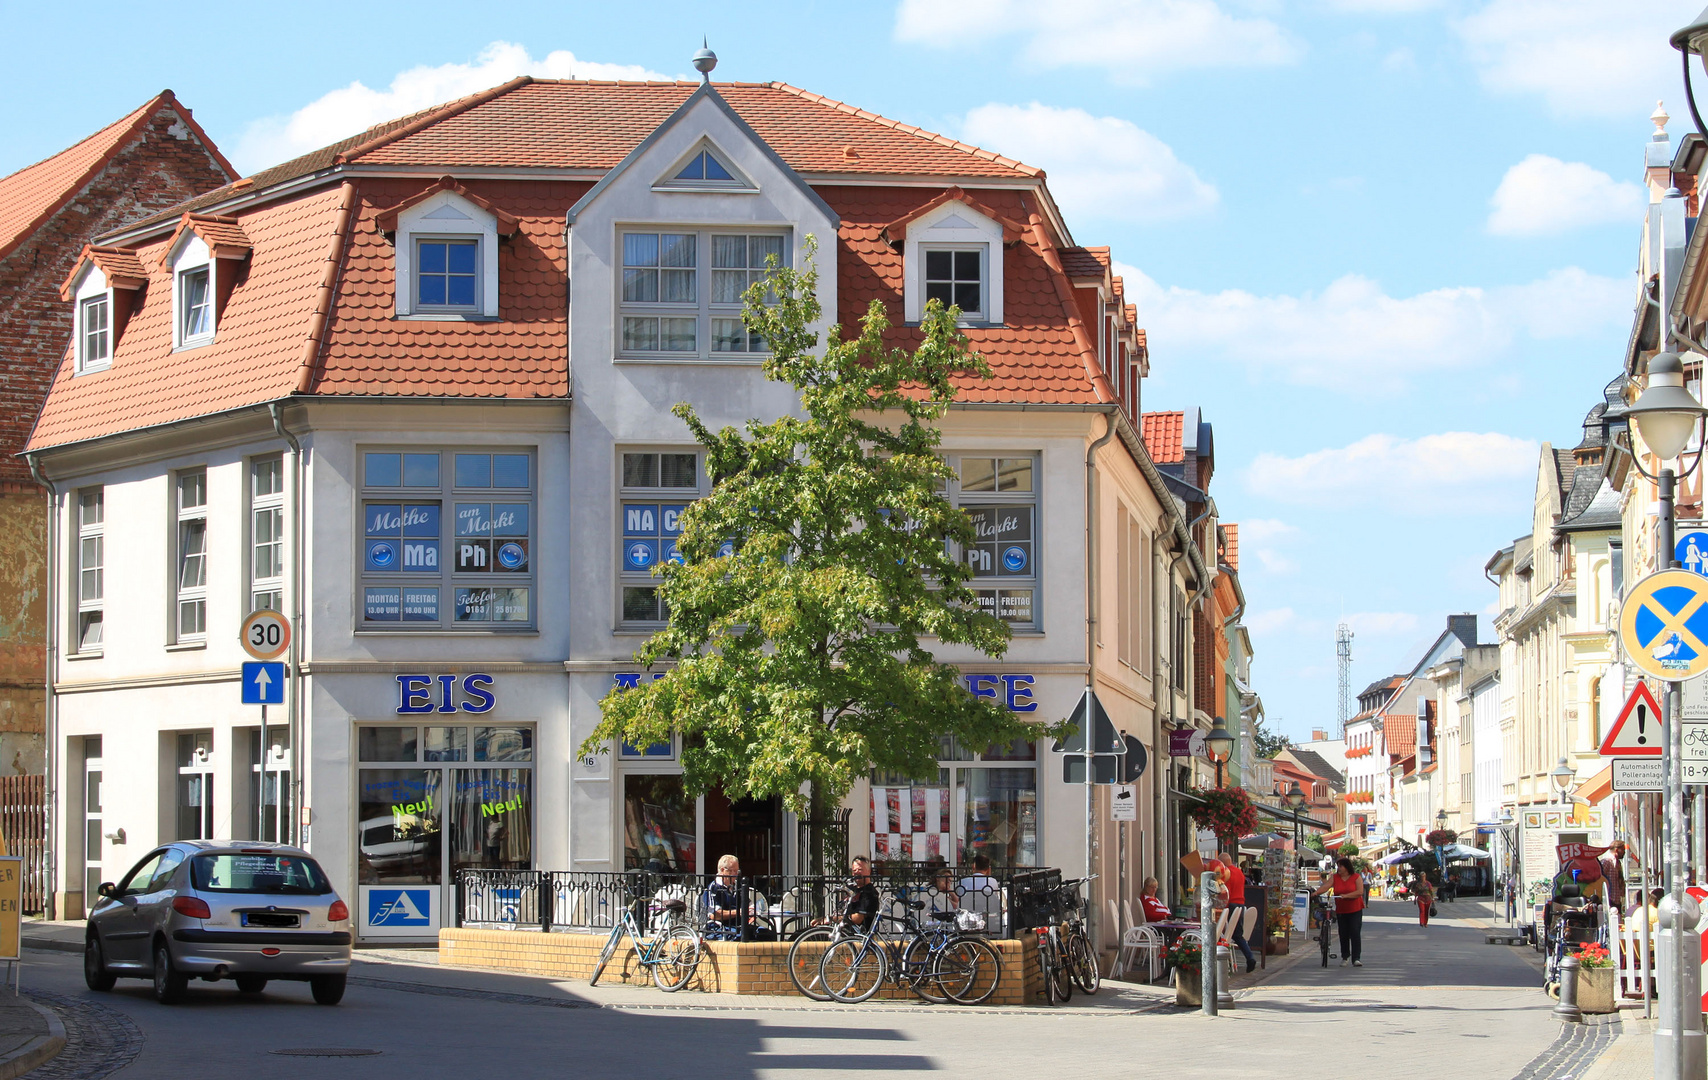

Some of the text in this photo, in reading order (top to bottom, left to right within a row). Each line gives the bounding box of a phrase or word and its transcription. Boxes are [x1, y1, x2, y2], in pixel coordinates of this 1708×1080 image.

[368, 508, 429, 532] Mathe
[459, 508, 480, 518] am
[628, 510, 654, 530] NA
[461, 512, 515, 534] Markt
[404, 544, 437, 567] Ma
[460, 544, 486, 567] Ph
[968, 550, 990, 570] Ph
[367, 594, 399, 604] MONTAG
[406, 594, 436, 604] FREITAG
[458, 590, 496, 606] Telefon
[1002, 597, 1030, 606] FREITAG
[252, 624, 280, 645] 30
[396, 673, 496, 714] EIS
[1691, 748, 1706, 756] frei
[586, 758, 594, 766] 16
[366, 779, 436, 792] Frozen Yogurt
[456, 780, 490, 792] Frozen
[392, 789, 410, 800] Eis
[483, 789, 501, 800] Eis
[392, 795, 433, 818] Neu!
[481, 794, 522, 817] Neu!
[1560, 844, 1581, 860] EIS
